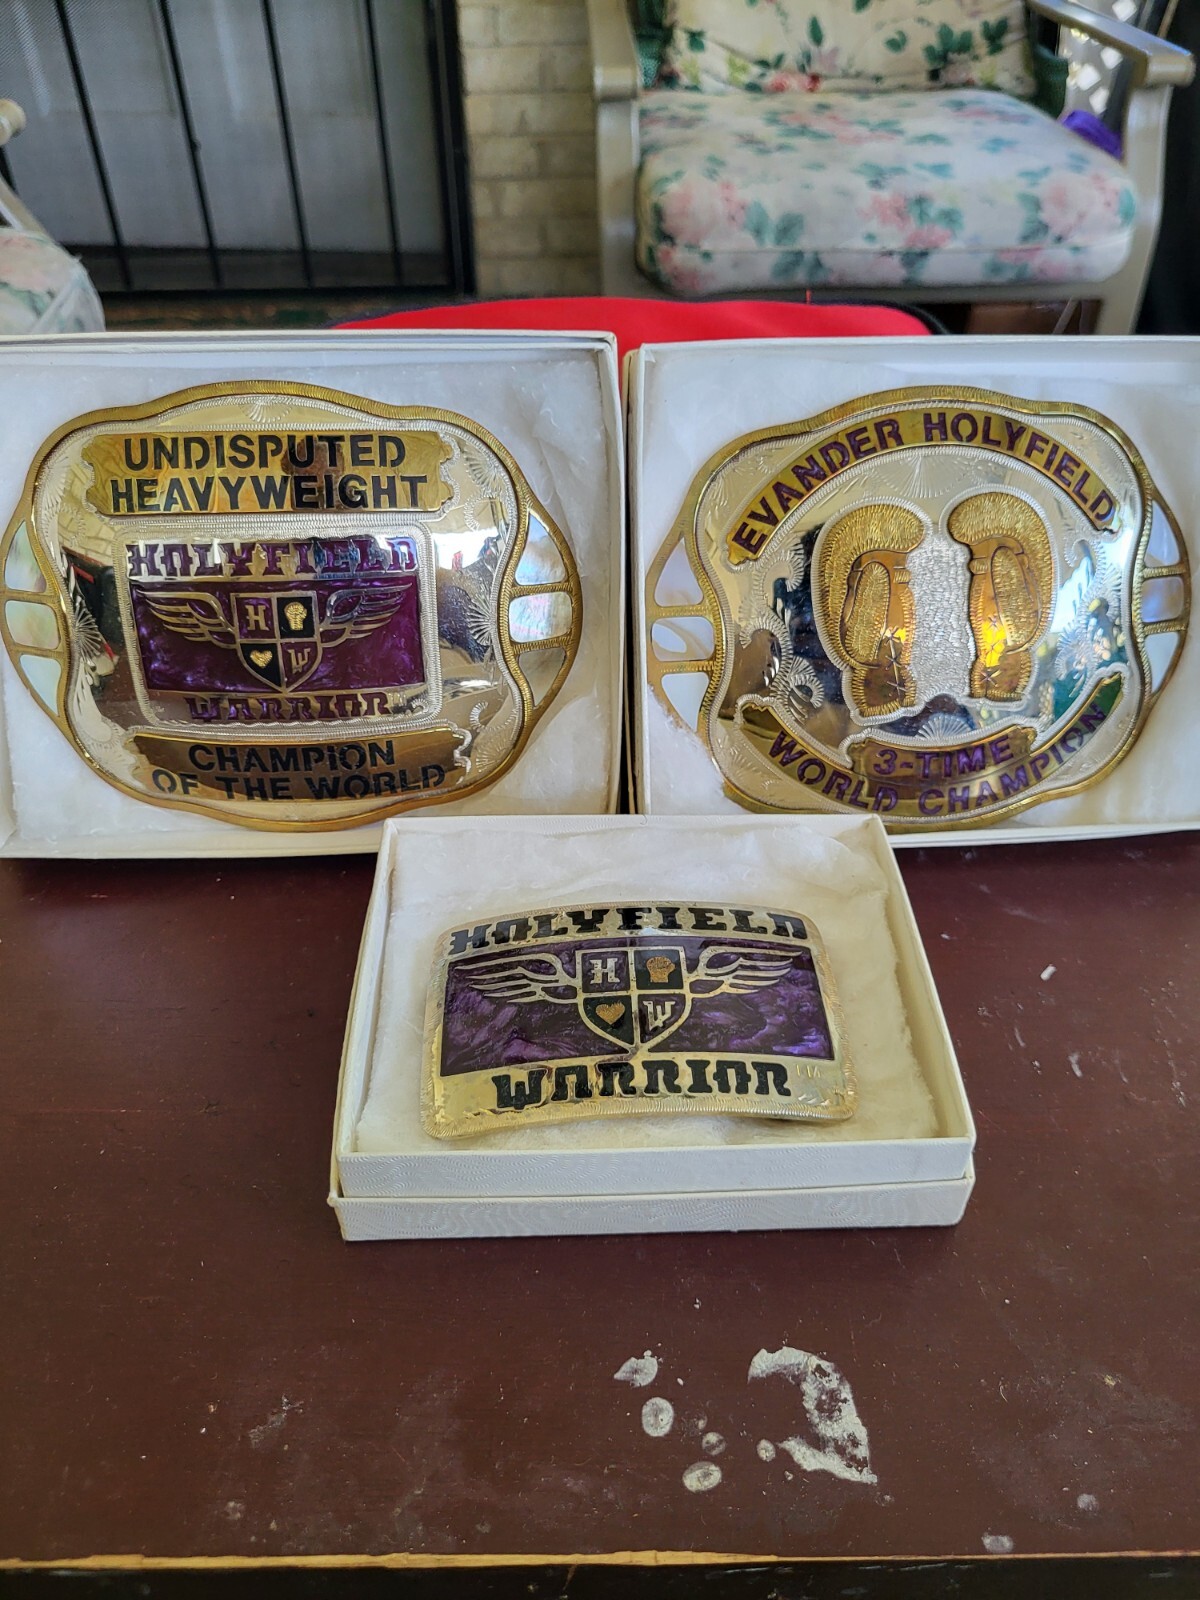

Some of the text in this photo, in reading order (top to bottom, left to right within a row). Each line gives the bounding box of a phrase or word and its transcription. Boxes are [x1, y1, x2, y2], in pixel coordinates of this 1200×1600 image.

[123, 434, 407, 471] UNDISPUTED
[110, 474, 428, 513] HEAVYWEIGHT
[732, 412, 1117, 554] EVANDER HOLYFIELD
[127, 541, 418, 577] HOLYFIELD
[186, 691, 392, 722] WARRIOR
[188, 740, 396, 772] CHAMPION
[768, 704, 1108, 816] WORLD CHAMPION
[873, 732, 1015, 780] 3-TIME
[153, 765, 446, 800] OF THE WORLD
[450, 907, 808, 955] HOLYFIELD
[589, 959, 620, 985] H
[491, 1059, 792, 1110] WARRIOR
